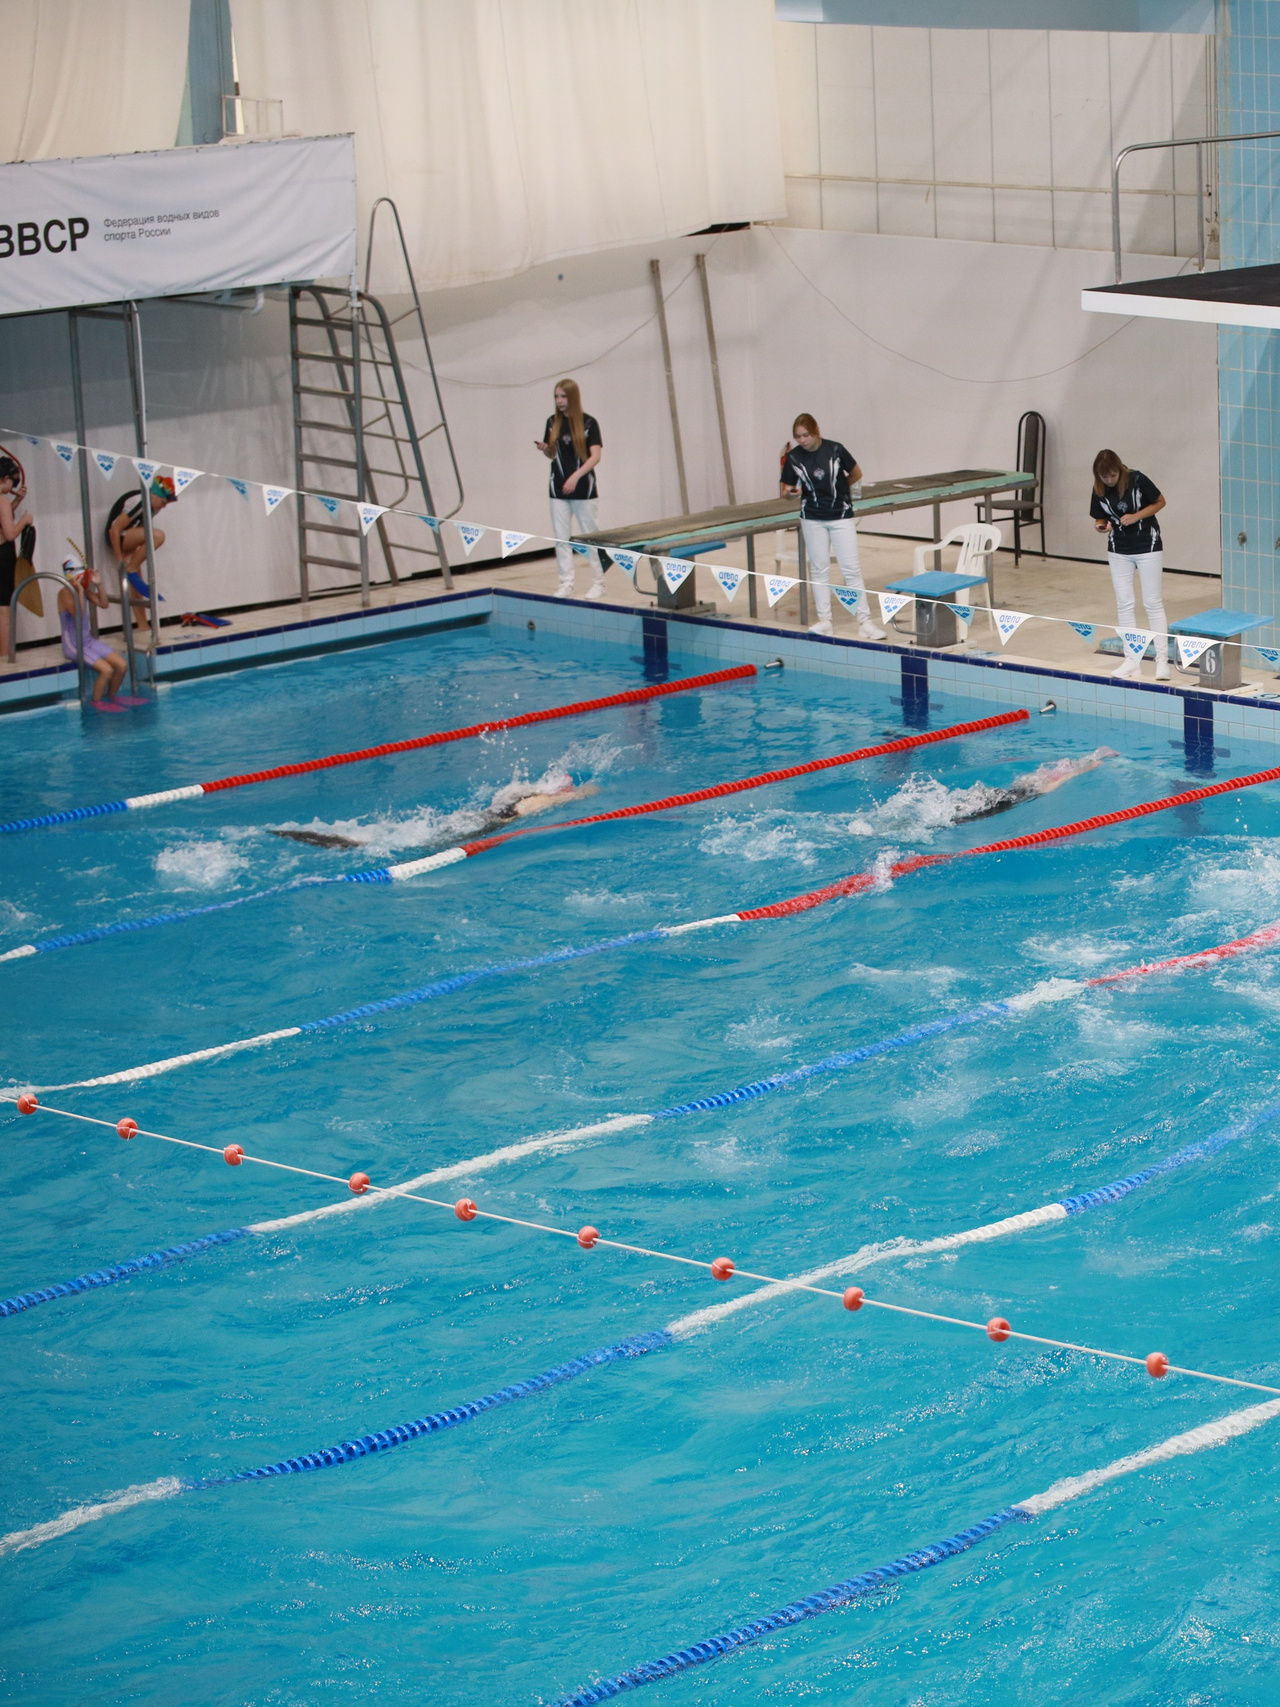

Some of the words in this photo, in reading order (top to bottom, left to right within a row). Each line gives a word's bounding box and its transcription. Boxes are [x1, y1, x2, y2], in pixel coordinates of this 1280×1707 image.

[103, 215, 155, 229] Федерация
[157, 212, 191, 223] водных
[193, 209, 220, 220] видов
[103, 230, 136, 242] спорта
[138, 228, 172, 239] России
[461, 526, 480, 537] arena
[614, 553, 634, 564] arena
[666, 562, 687, 573] arena
[718, 571, 739, 582] arena
[769, 578, 792, 588] arena
[835, 588, 858, 598] arena
[884, 596, 906, 605] arena
[999, 614, 1021, 624] arena
[1125, 632, 1147, 644] arena
[1183, 639, 1208, 649] arena
[1205, 649, 1217, 674] 6
